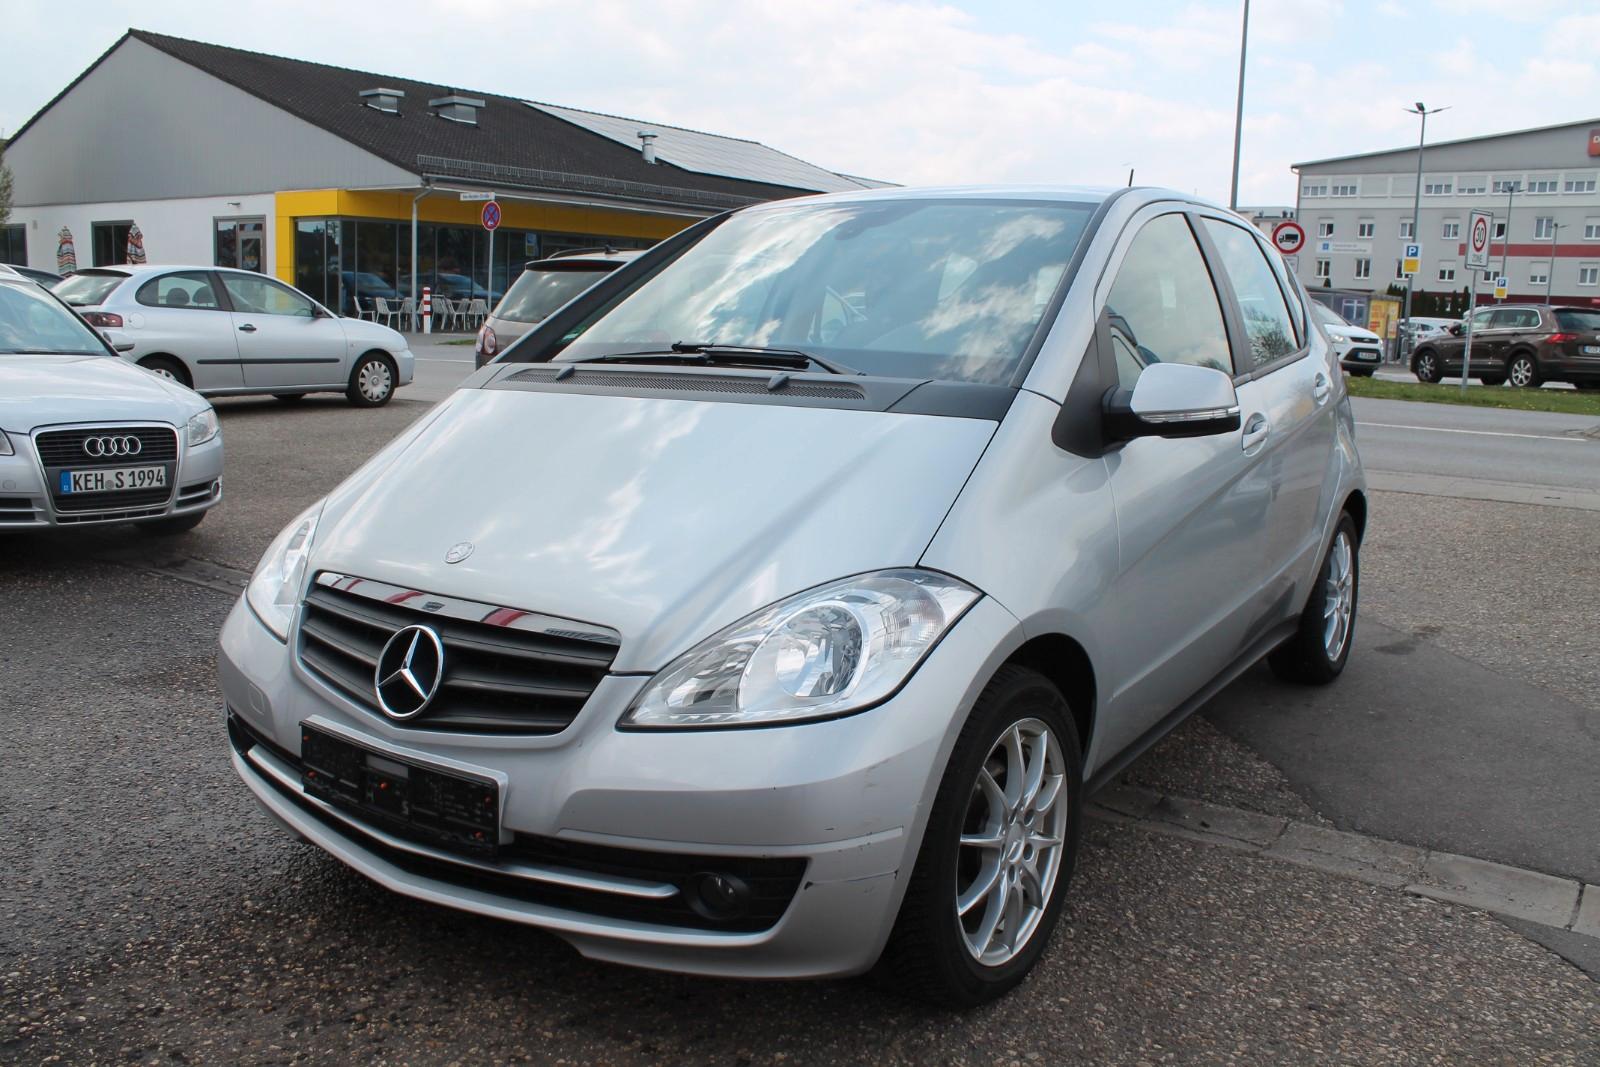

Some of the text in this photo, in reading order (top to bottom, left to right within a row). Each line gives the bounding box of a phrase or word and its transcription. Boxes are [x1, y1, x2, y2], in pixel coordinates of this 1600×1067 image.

[1476, 227, 1484, 243] 30
[1409, 246, 1416, 256] P
[73, 469, 163, 491] KEH S 1994
